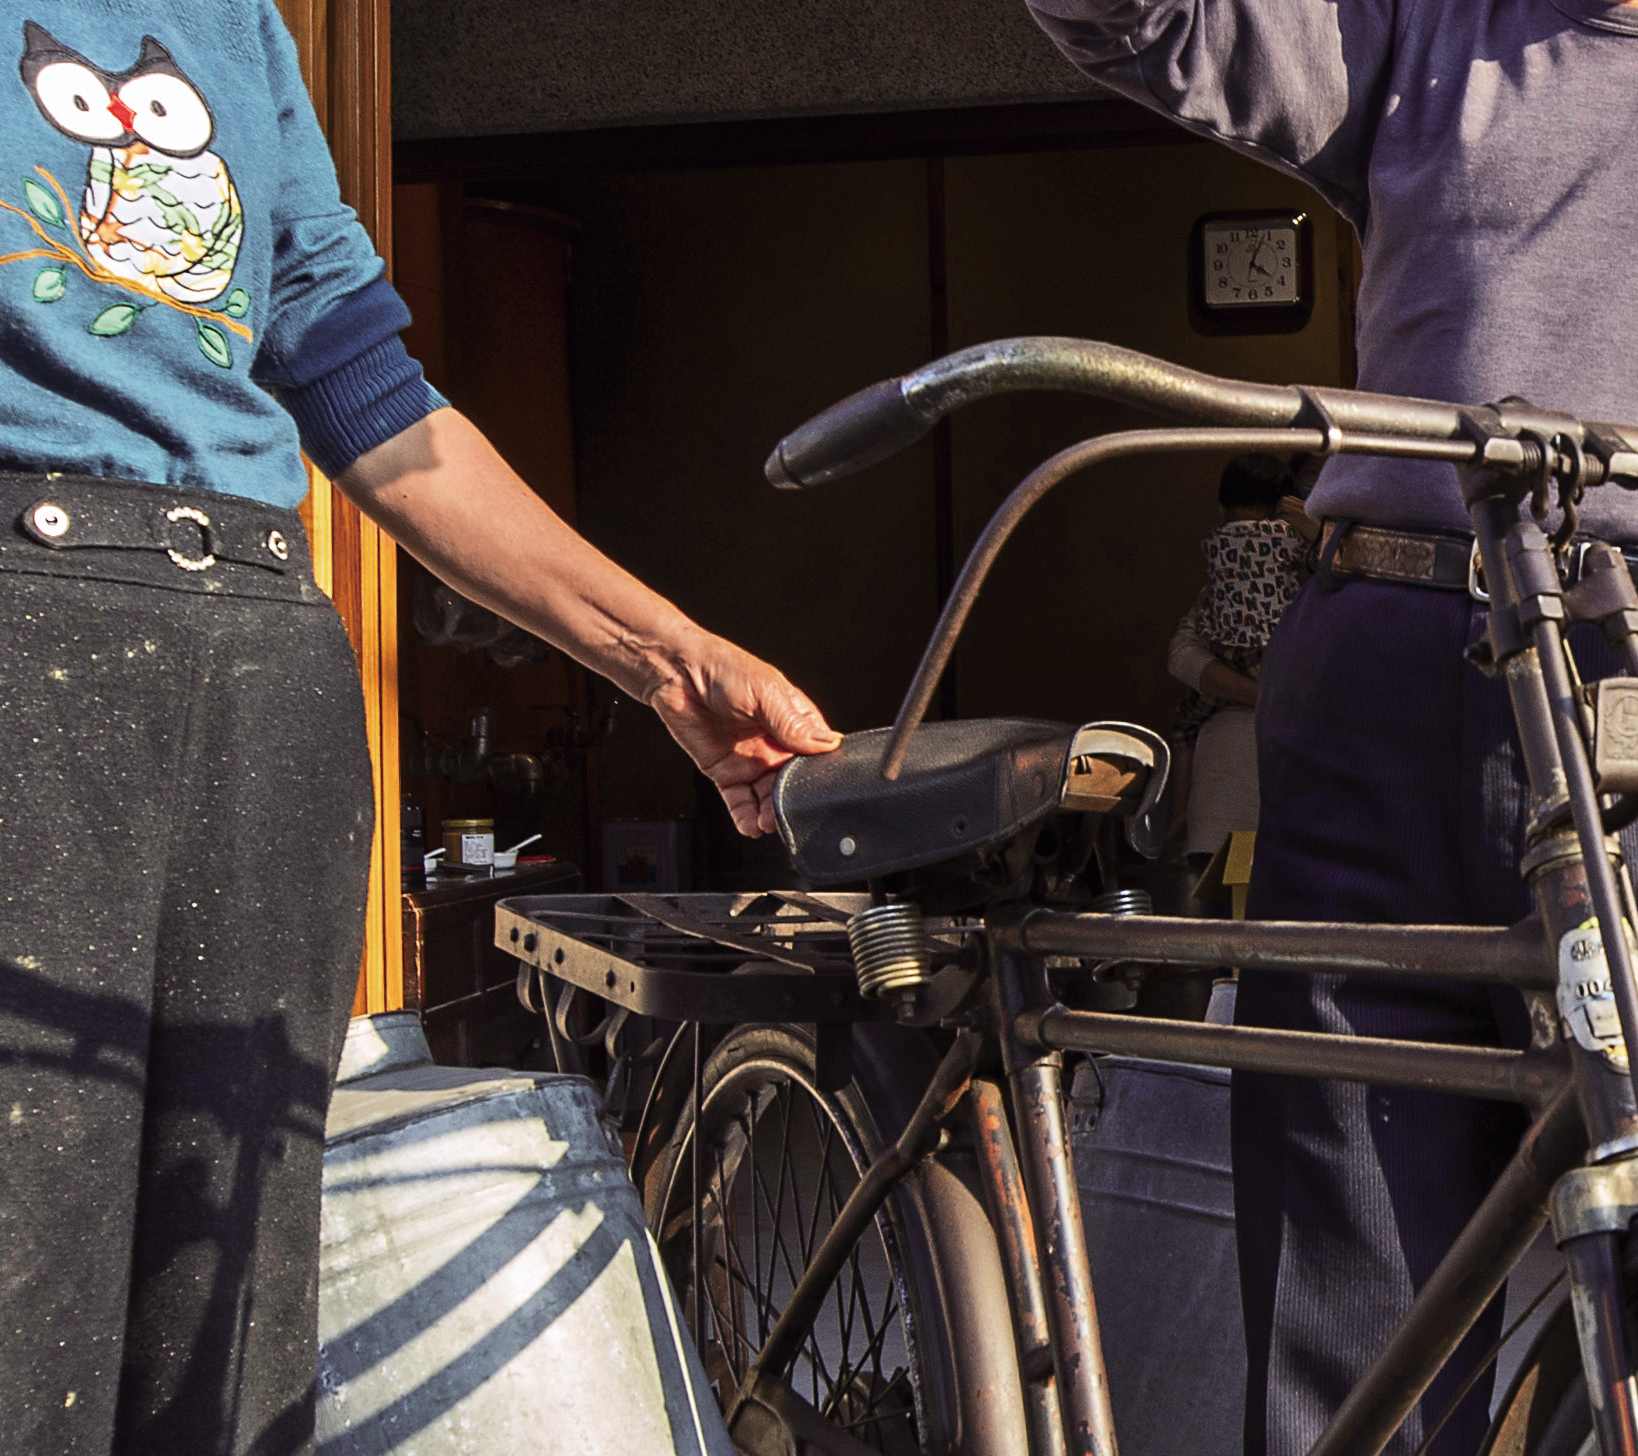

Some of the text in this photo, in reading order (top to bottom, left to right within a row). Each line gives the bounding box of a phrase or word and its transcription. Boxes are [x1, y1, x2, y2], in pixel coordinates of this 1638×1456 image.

[1230, 232, 1240, 243] 11
[1246, 228, 1259, 239] 12
[1266, 231, 1272, 241] 1
[1216, 244, 1228, 254] 10
[1276, 239, 1286, 250] 2
[1213, 260, 1223, 271] 9
[1282, 257, 1292, 268] 3
[1218, 277, 1228, 288] 8
[1277, 275, 1285, 286] 4
[1232, 287, 1242, 298] 7
[1248, 289, 1258, 300] 6
[1264, 286, 1274, 297] 5
[1576, 979, 1613, 998] 00
